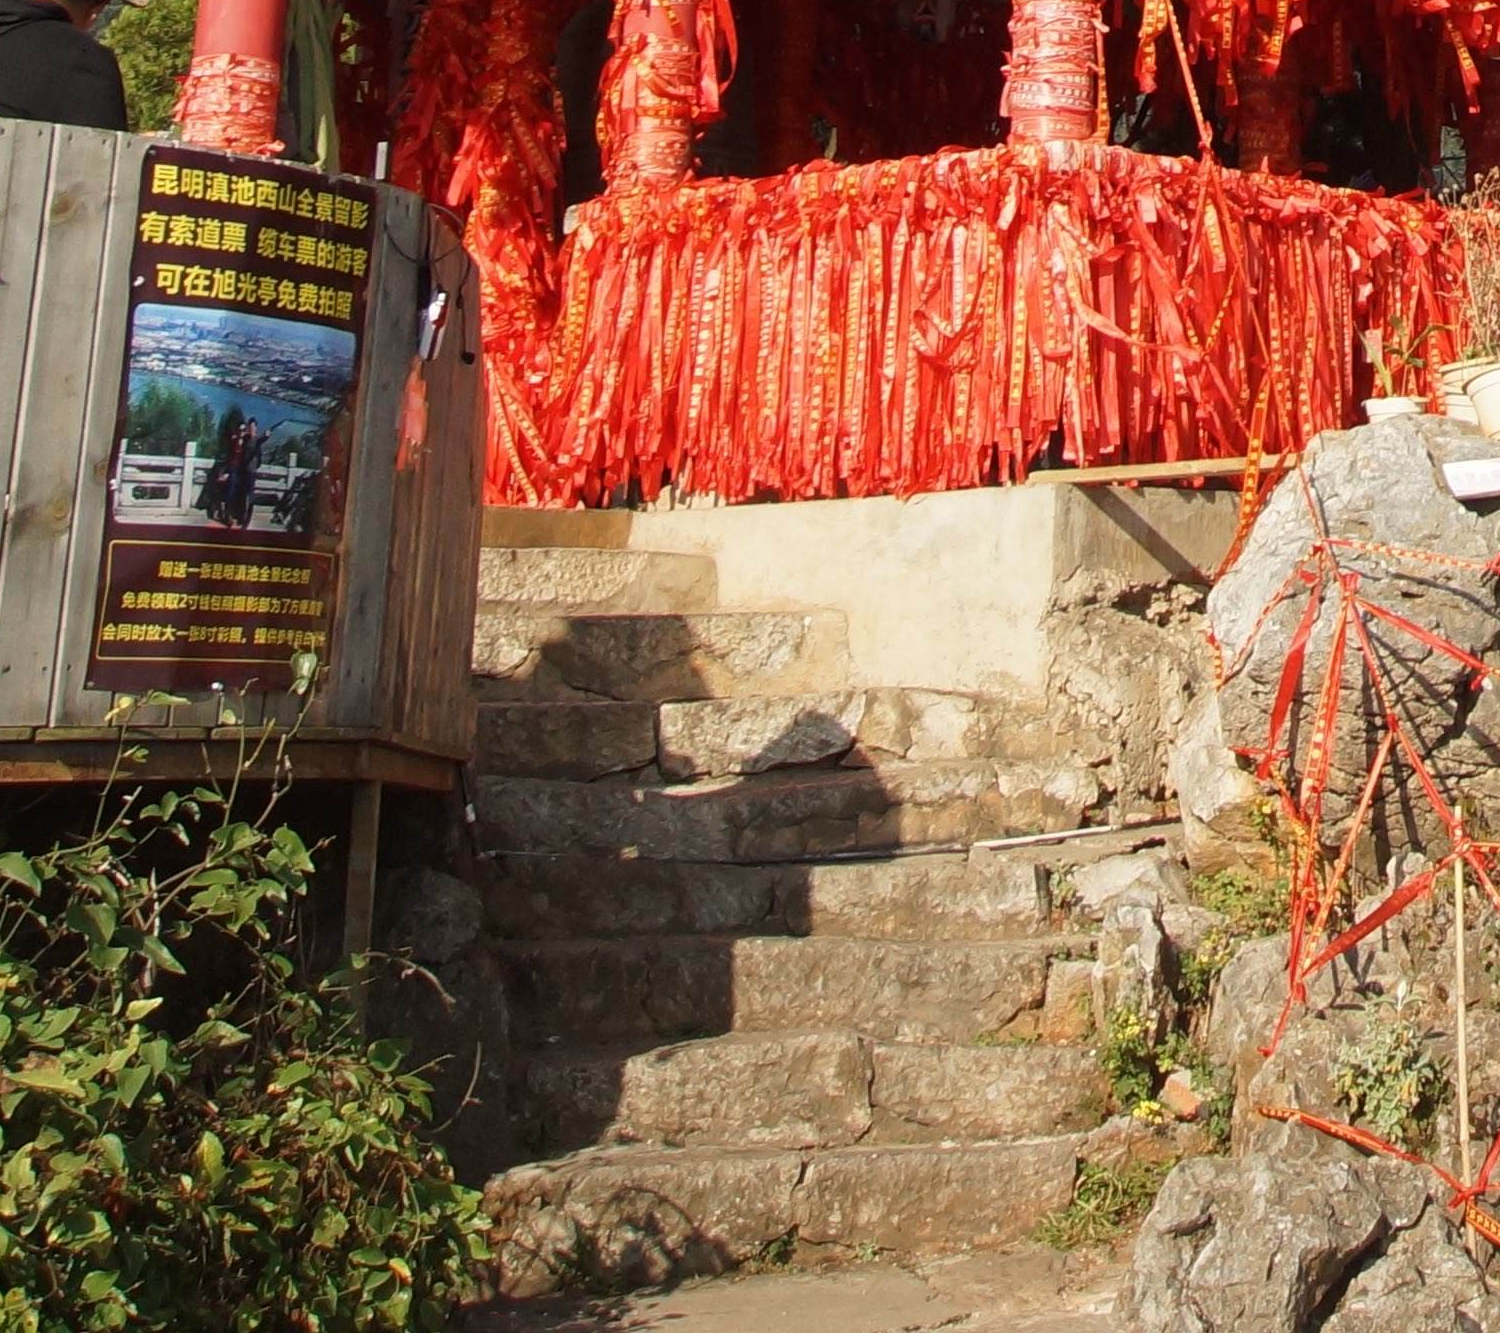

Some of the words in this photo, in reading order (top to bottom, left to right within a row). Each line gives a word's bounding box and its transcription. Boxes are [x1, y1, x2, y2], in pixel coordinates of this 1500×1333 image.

[151, 164, 370, 230] 昆明滇池西山全景留影
[139, 211, 248, 253] 有索道票
[256, 226, 369, 278] 缆车票的游客
[156, 262, 354, 321] 可在旭光亭免费拍照
